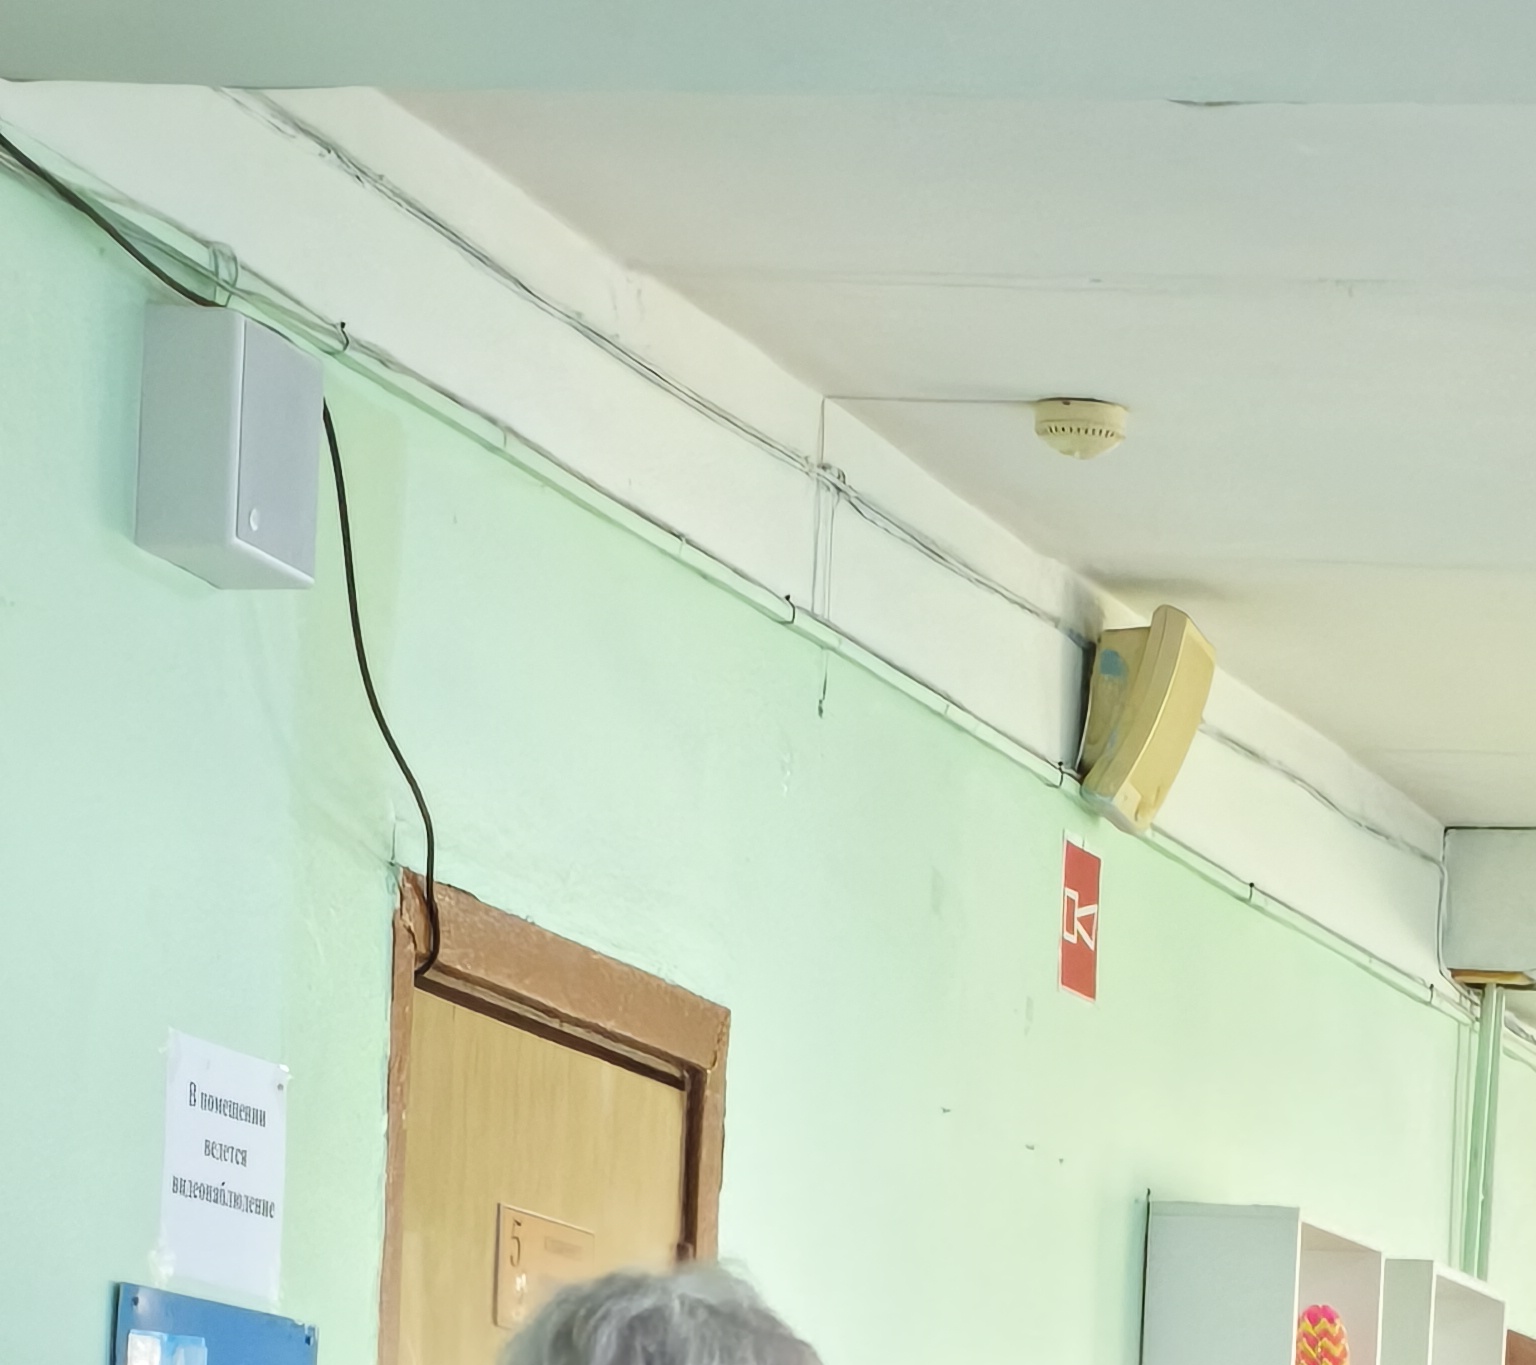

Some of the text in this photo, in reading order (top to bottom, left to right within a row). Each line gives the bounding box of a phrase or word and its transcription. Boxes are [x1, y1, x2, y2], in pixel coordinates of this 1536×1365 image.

[188, 1081, 267, 1128] В помещении
[171, 1175, 275, 1219] видеонаблюдение
